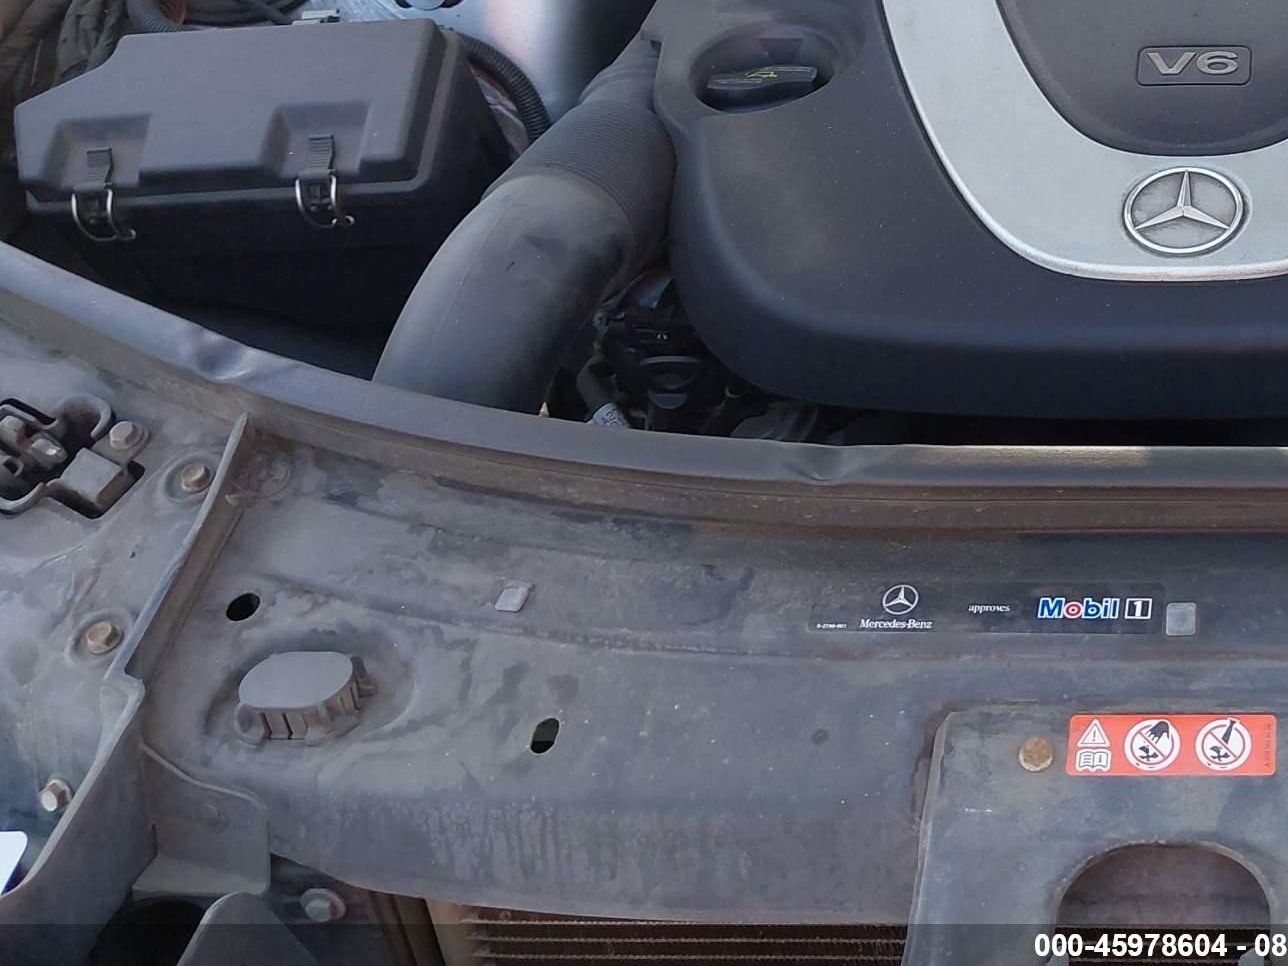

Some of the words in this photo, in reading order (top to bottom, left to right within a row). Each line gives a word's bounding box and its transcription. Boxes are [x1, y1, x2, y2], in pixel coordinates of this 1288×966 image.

[1147, 51, 1239, 75] V6
[968, 603, 1011, 614] approves
[1037, 597, 1120, 619] Mobil
[859, 618, 933, 629] Mercedes-Benz
